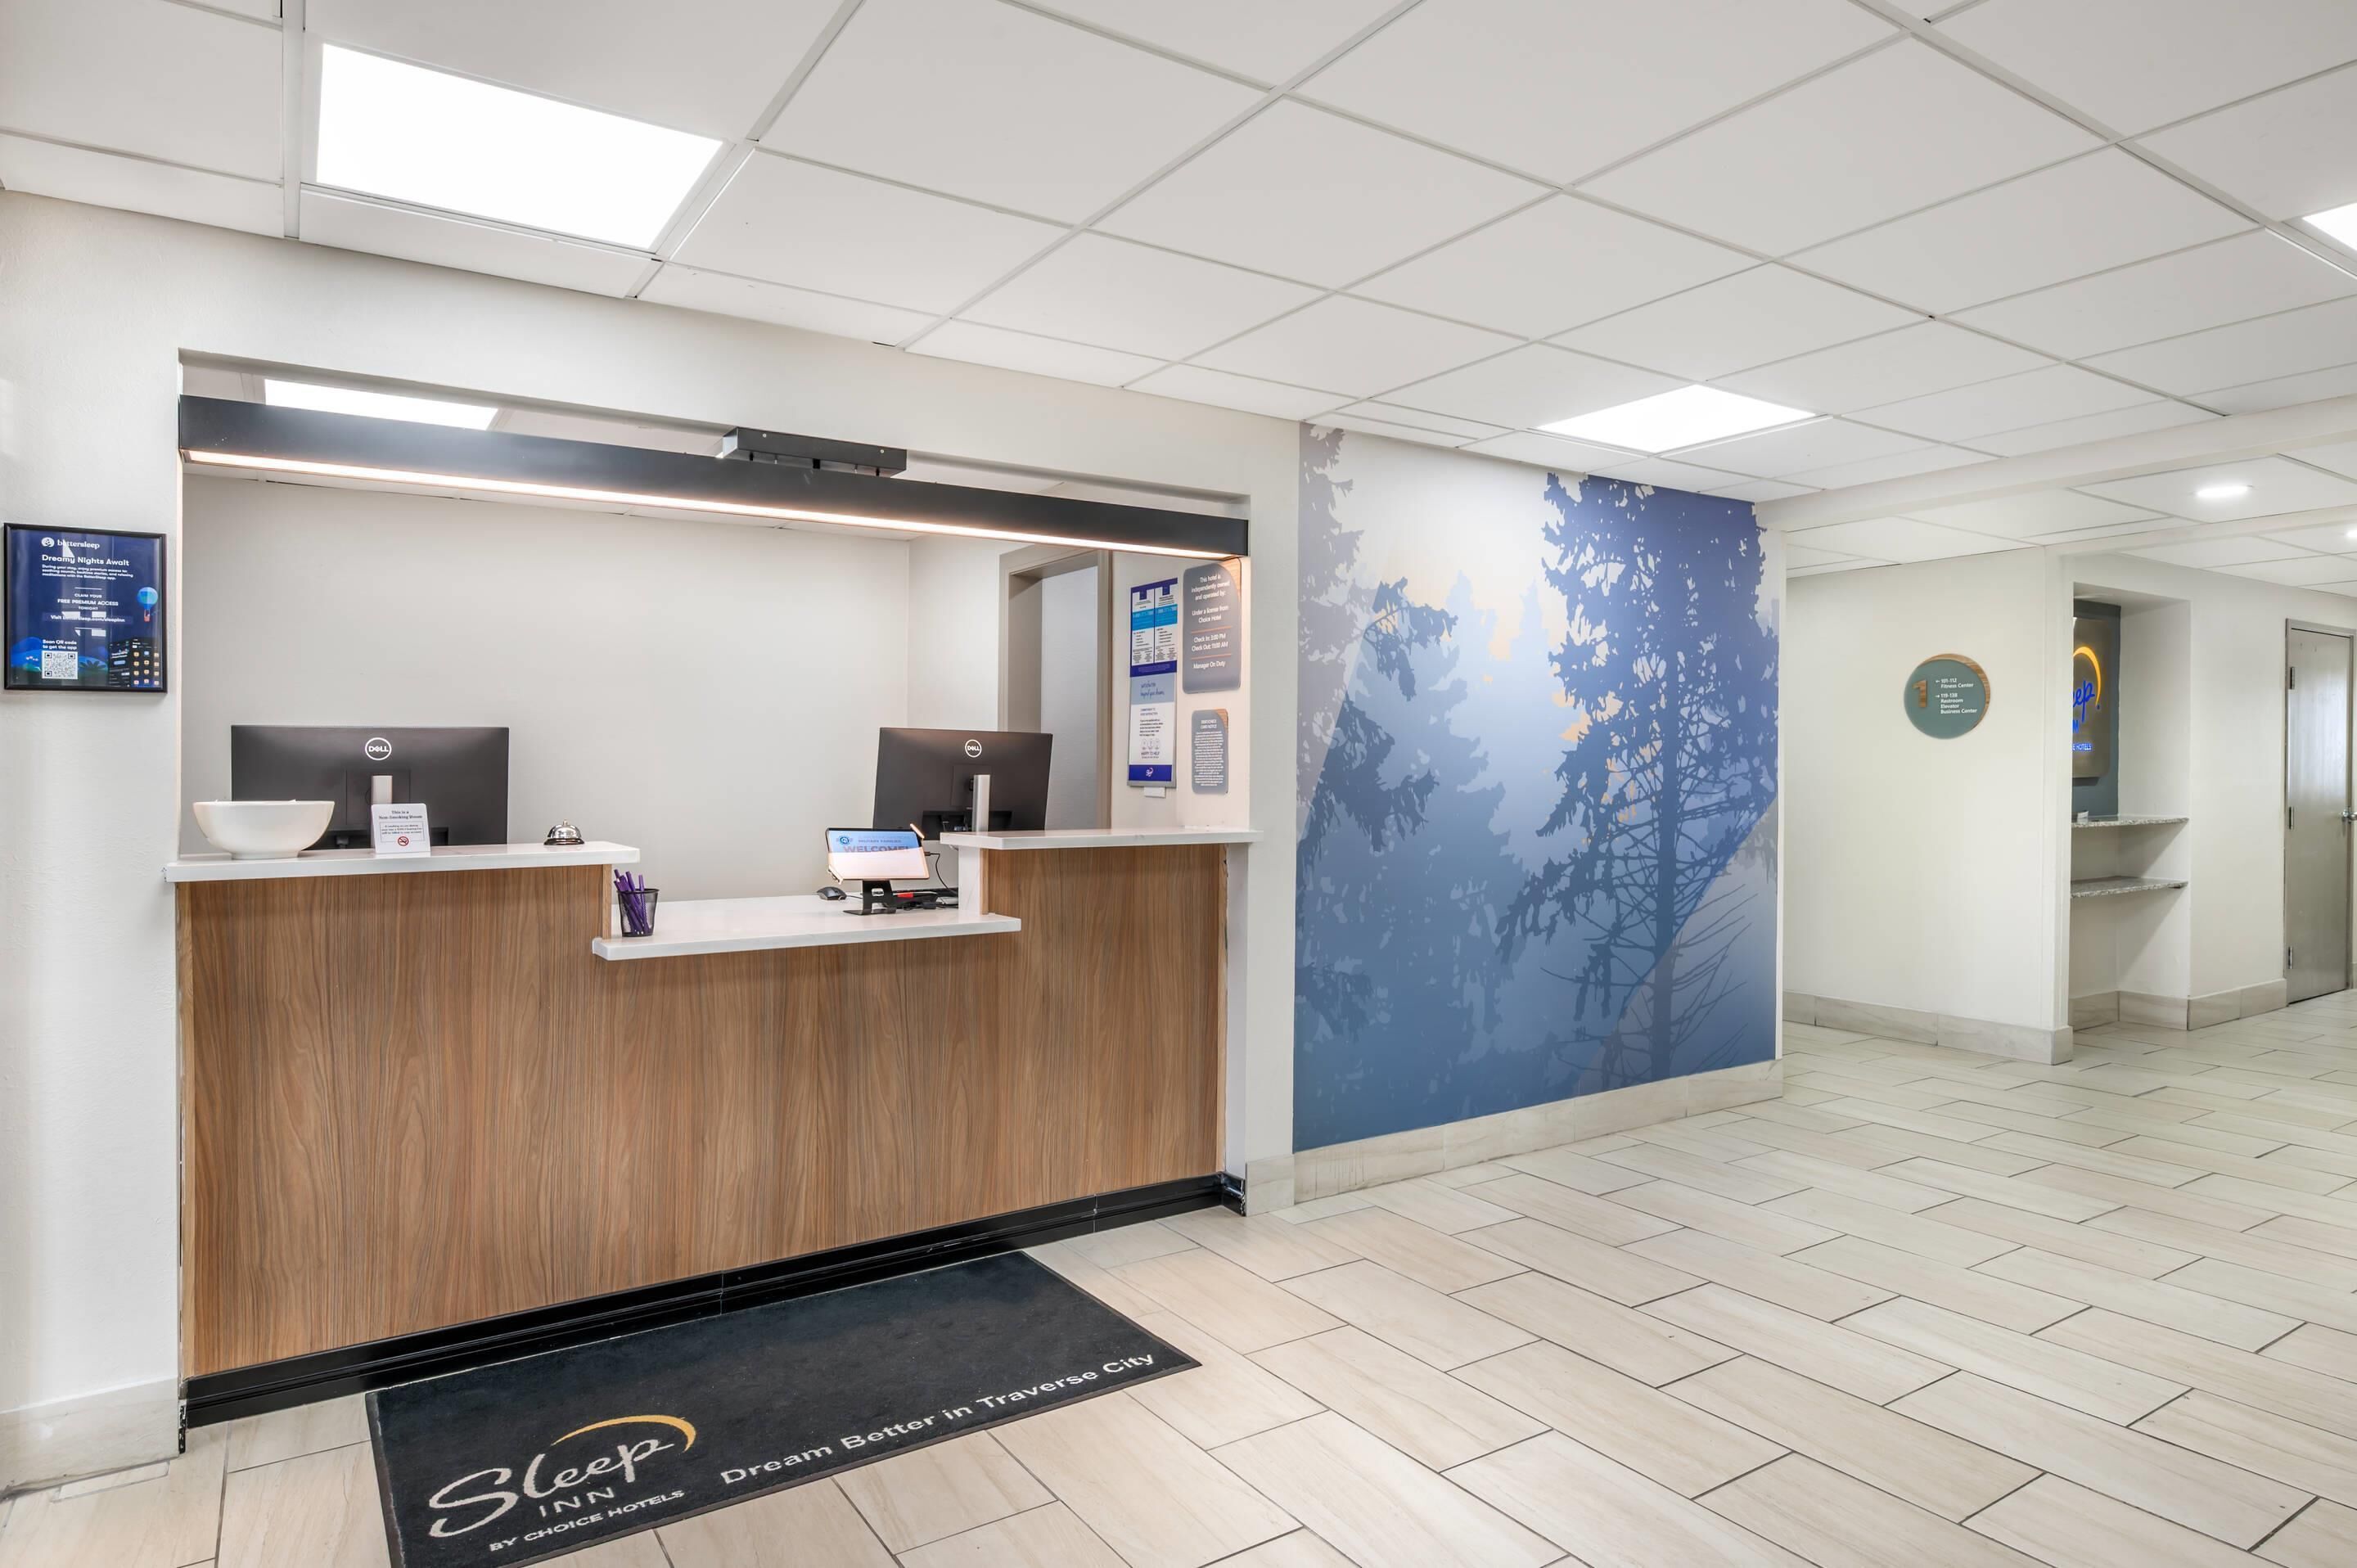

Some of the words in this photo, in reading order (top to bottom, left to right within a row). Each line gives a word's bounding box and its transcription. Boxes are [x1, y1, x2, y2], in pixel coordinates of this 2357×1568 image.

[57, 539, 100, 549] bttersleep
[42, 554, 75, 564] Dreamy
[78, 556, 104, 565] Nights
[1192, 583, 1216, 593] independently
[1203, 591, 1219, 600] operated
[1912, 680, 1927, 707] 1
[720, 1446, 833, 1485] Dream
[840, 1416, 935, 1449] Better
[942, 1403, 974, 1420] in
[976, 1368, 1097, 1410] Traverse
[1102, 1354, 1156, 1375] City
[428, 1439, 674, 1538] Sleep
[539, 1486, 615, 1518] INN
[489, 1537, 517, 1552] BY
[524, 1513, 604, 1542] CHOICE
[608, 1489, 685, 1517] HOTELS
